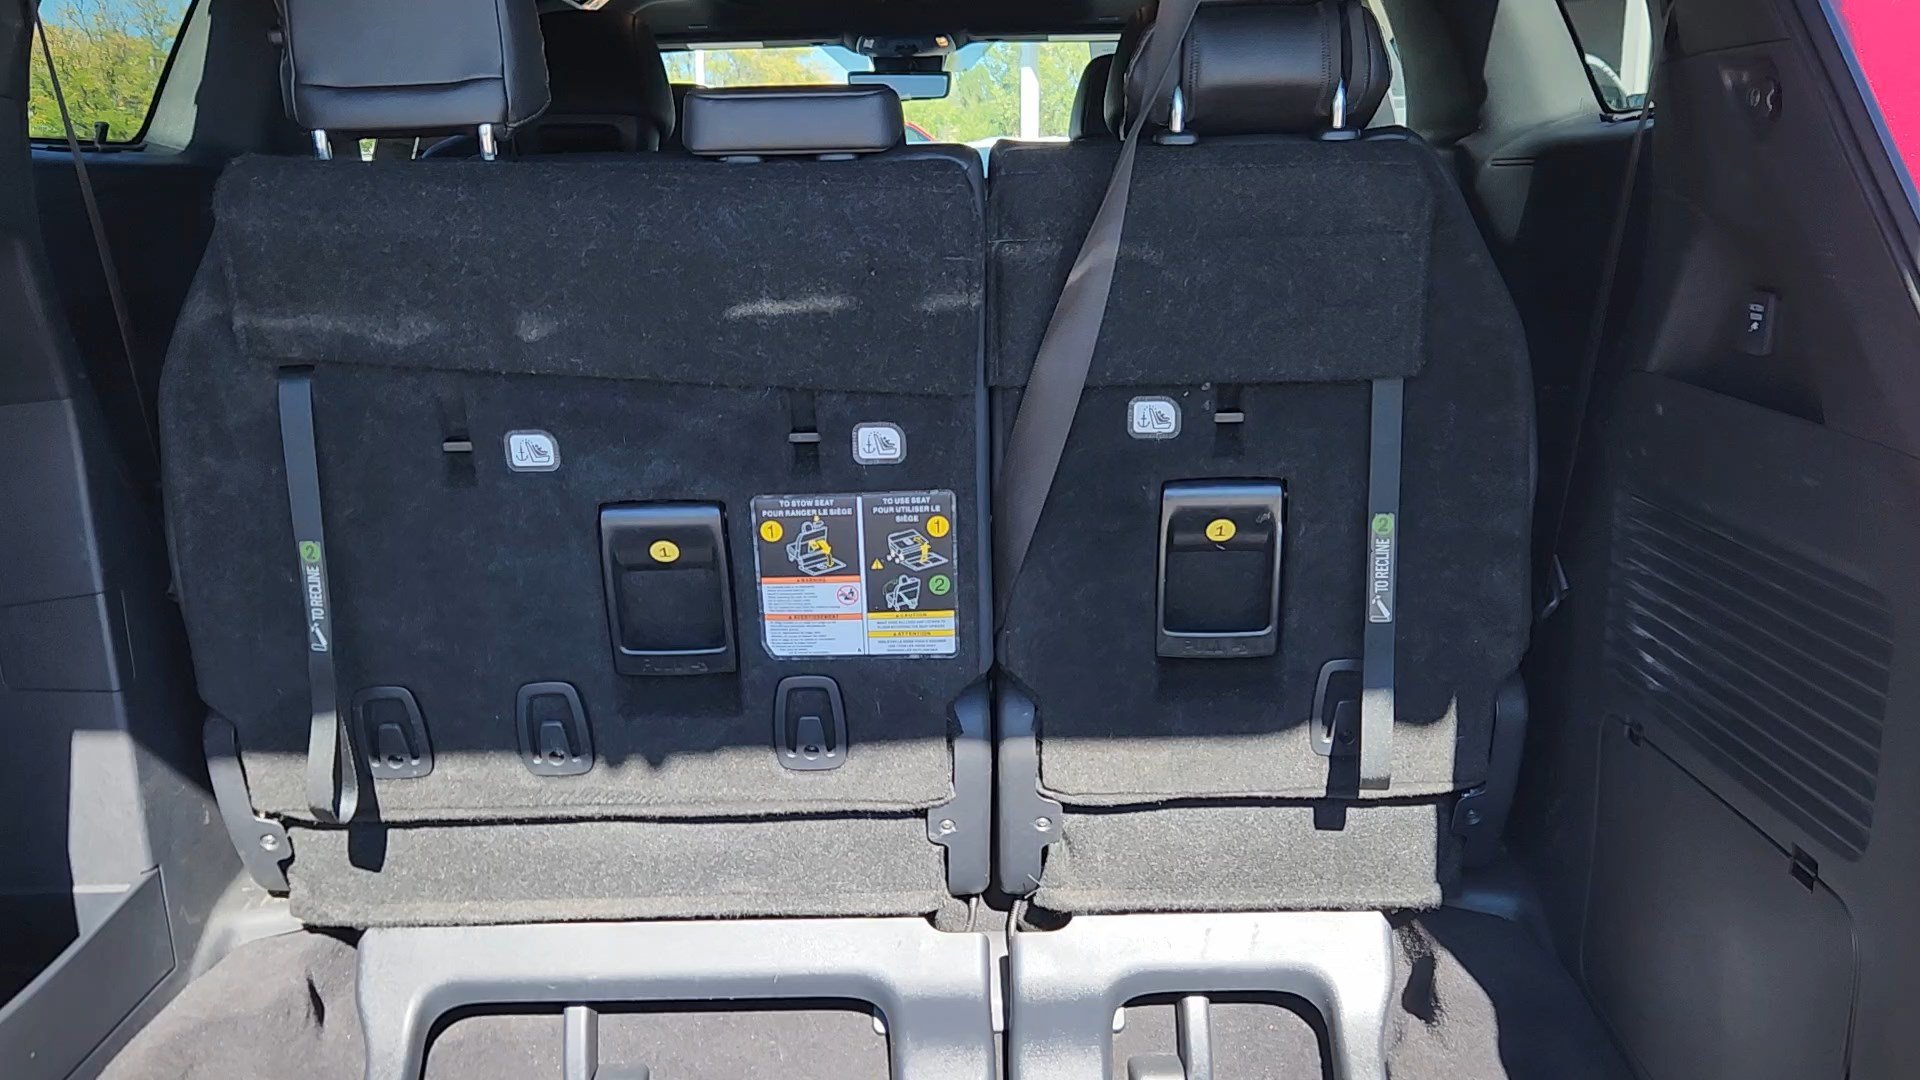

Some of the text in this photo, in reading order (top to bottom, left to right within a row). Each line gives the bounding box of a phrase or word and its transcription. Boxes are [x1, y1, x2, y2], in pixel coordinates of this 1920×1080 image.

[779, 500, 789, 508] TO
[814, 499, 834, 507] SEAT
[911, 496, 931, 504] SEAT
[762, 510, 784, 518] POUR
[785, 509, 817, 517] RANGER
[818, 508, 828, 516] LE
[895, 505, 929, 513] UTILISER
[1378, 517, 1388, 532] 2
[1214, 525, 1226, 537] 1
[305, 544, 316, 560] 2
[659, 546, 672, 558] 1
[1374, 538, 1391, 594] TO RECLINE
[934, 578, 945, 592] 2
[306, 565, 325, 621] TO RECLINE
